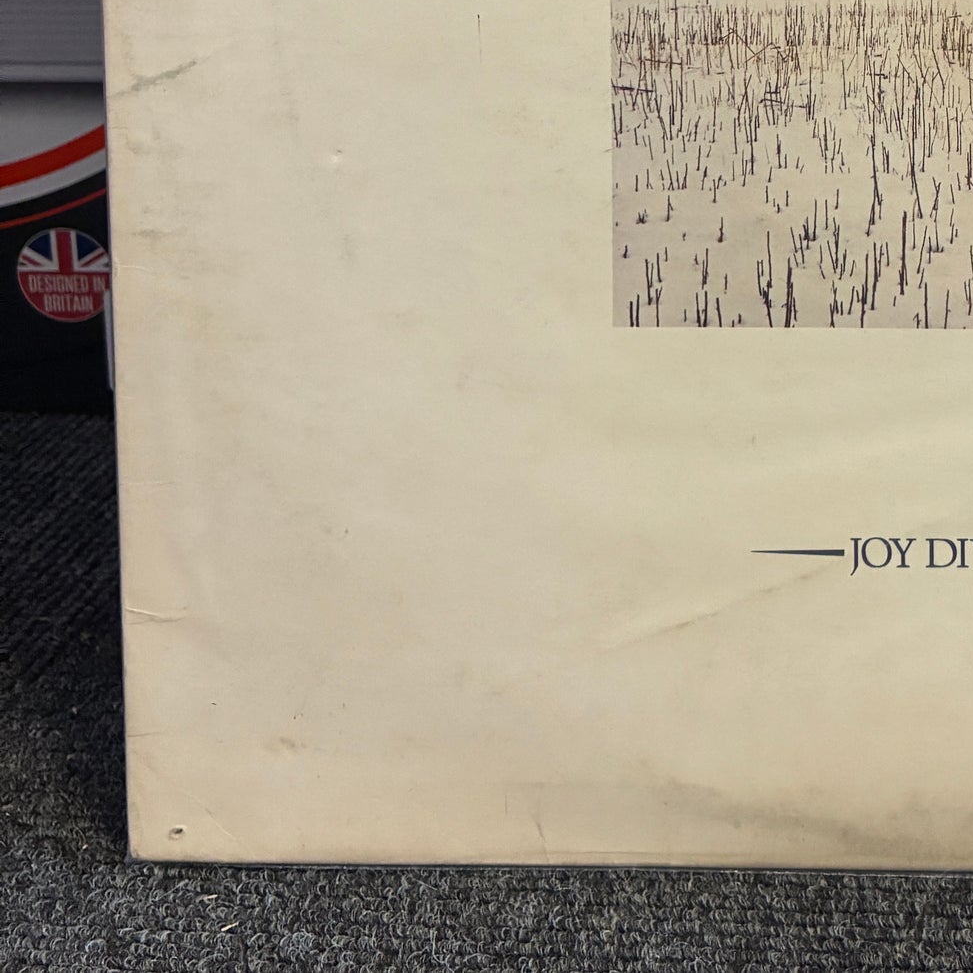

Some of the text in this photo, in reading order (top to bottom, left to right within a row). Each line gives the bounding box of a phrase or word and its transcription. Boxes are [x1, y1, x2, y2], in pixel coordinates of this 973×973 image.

[28, 274, 106, 293] DESIGNED IN
[44, 294, 94, 312] BRITAIN
[850, 537, 917, 576] JOY
